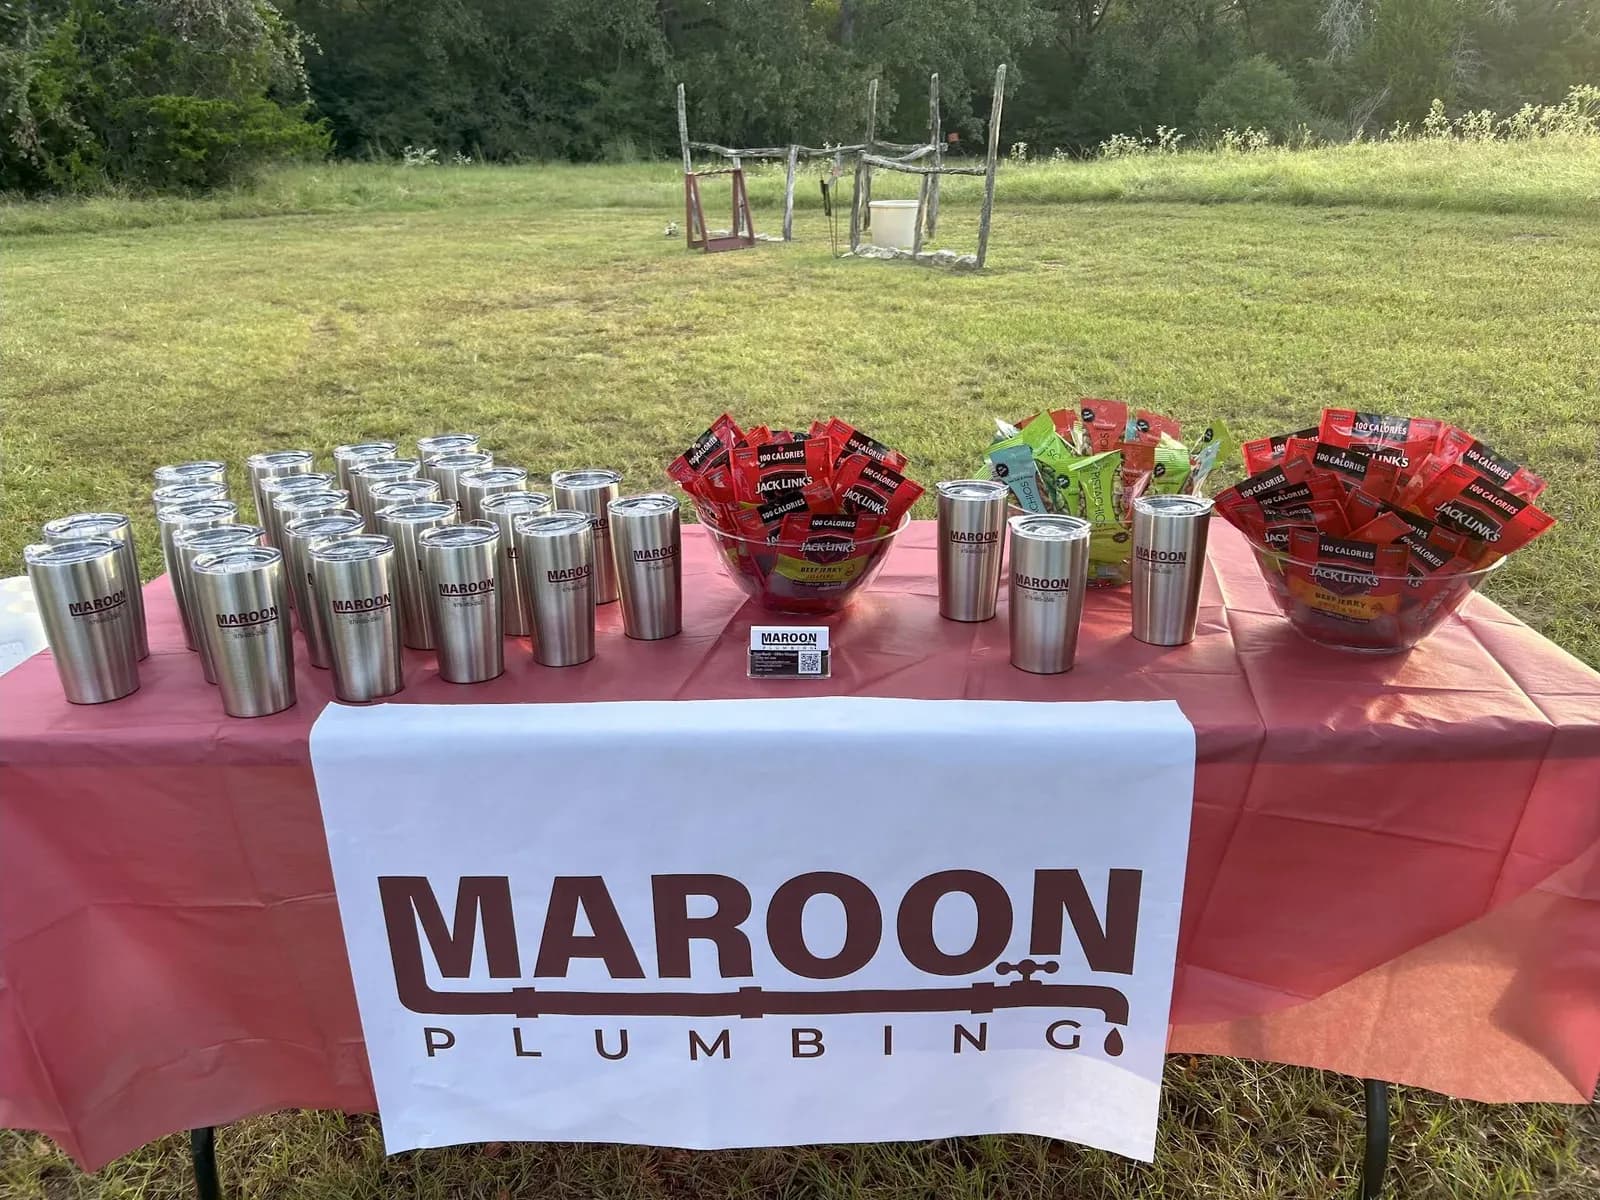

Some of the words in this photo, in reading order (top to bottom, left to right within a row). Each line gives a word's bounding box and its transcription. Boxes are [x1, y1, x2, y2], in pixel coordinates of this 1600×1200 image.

[1355, 422, 1368, 430] 100
[1369, 423, 1407, 435] CALORIES
[760, 454, 770, 462] 100
[772, 449, 805, 460] CALORIES
[848, 438, 859, 448] 100
[858, 442, 885, 460] CALORIES
[1273, 443, 1285, 454] 100
[1317, 452, 1329, 462] 100
[1329, 456, 1365, 473] CALORIES
[1466, 449, 1480, 461] 100
[1478, 456, 1512, 480] CALORIES
[862, 467, 873, 476] 100
[872, 471, 899, 489] CALORIES
[1241, 488, 1254, 498] 100
[1253, 474, 1286, 494] CALORIES
[755, 480, 781, 495] JACK
[841, 487, 863, 505] JACK
[1272, 488, 1310, 503] CALORIES
[762, 510, 774, 519] 100
[773, 498, 805, 515] CALORIES
[1469, 484, 1483, 495] 100
[1481, 491, 1519, 515] CALORIES
[1434, 502, 1468, 524] JACK
[825, 519, 856, 528] CALORIES
[951, 530, 999, 542] MAROON
[799, 542, 824, 552] JACK
[1136, 546, 1187, 562] MAROON
[1321, 544, 1334, 552] 100
[1335, 546, 1375, 559] CALORIES
[1411, 541, 1445, 567] CALORIES
[1016, 573, 1070, 589] MAROON
[1309, 566, 1339, 582] JACK
[439, 578, 494, 595] MAROON
[69, 589, 127, 614] MAROON
[332, 592, 391, 612] MAROON
[216, 605, 279, 626] MAROON
[761, 633, 817, 643] MAROON
[377, 868, 1143, 980] MAROON
[423, 1018, 1083, 1061] PLUMBING
